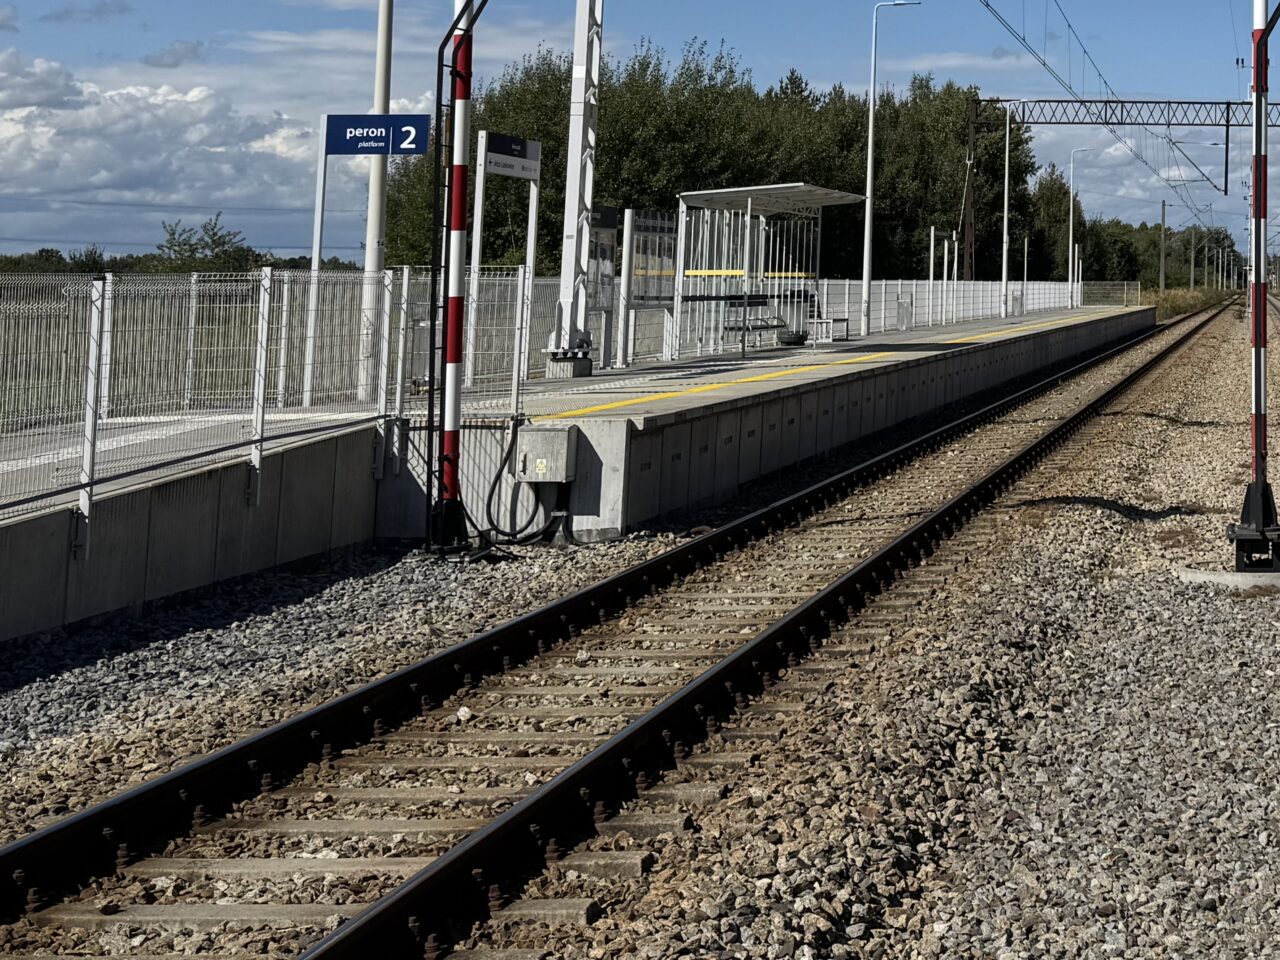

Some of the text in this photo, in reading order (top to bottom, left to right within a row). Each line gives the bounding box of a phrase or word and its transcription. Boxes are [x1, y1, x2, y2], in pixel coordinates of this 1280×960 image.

[346, 127, 386, 140] peron
[399, 125, 417, 149] 2
[358, 140, 386, 149] platform
